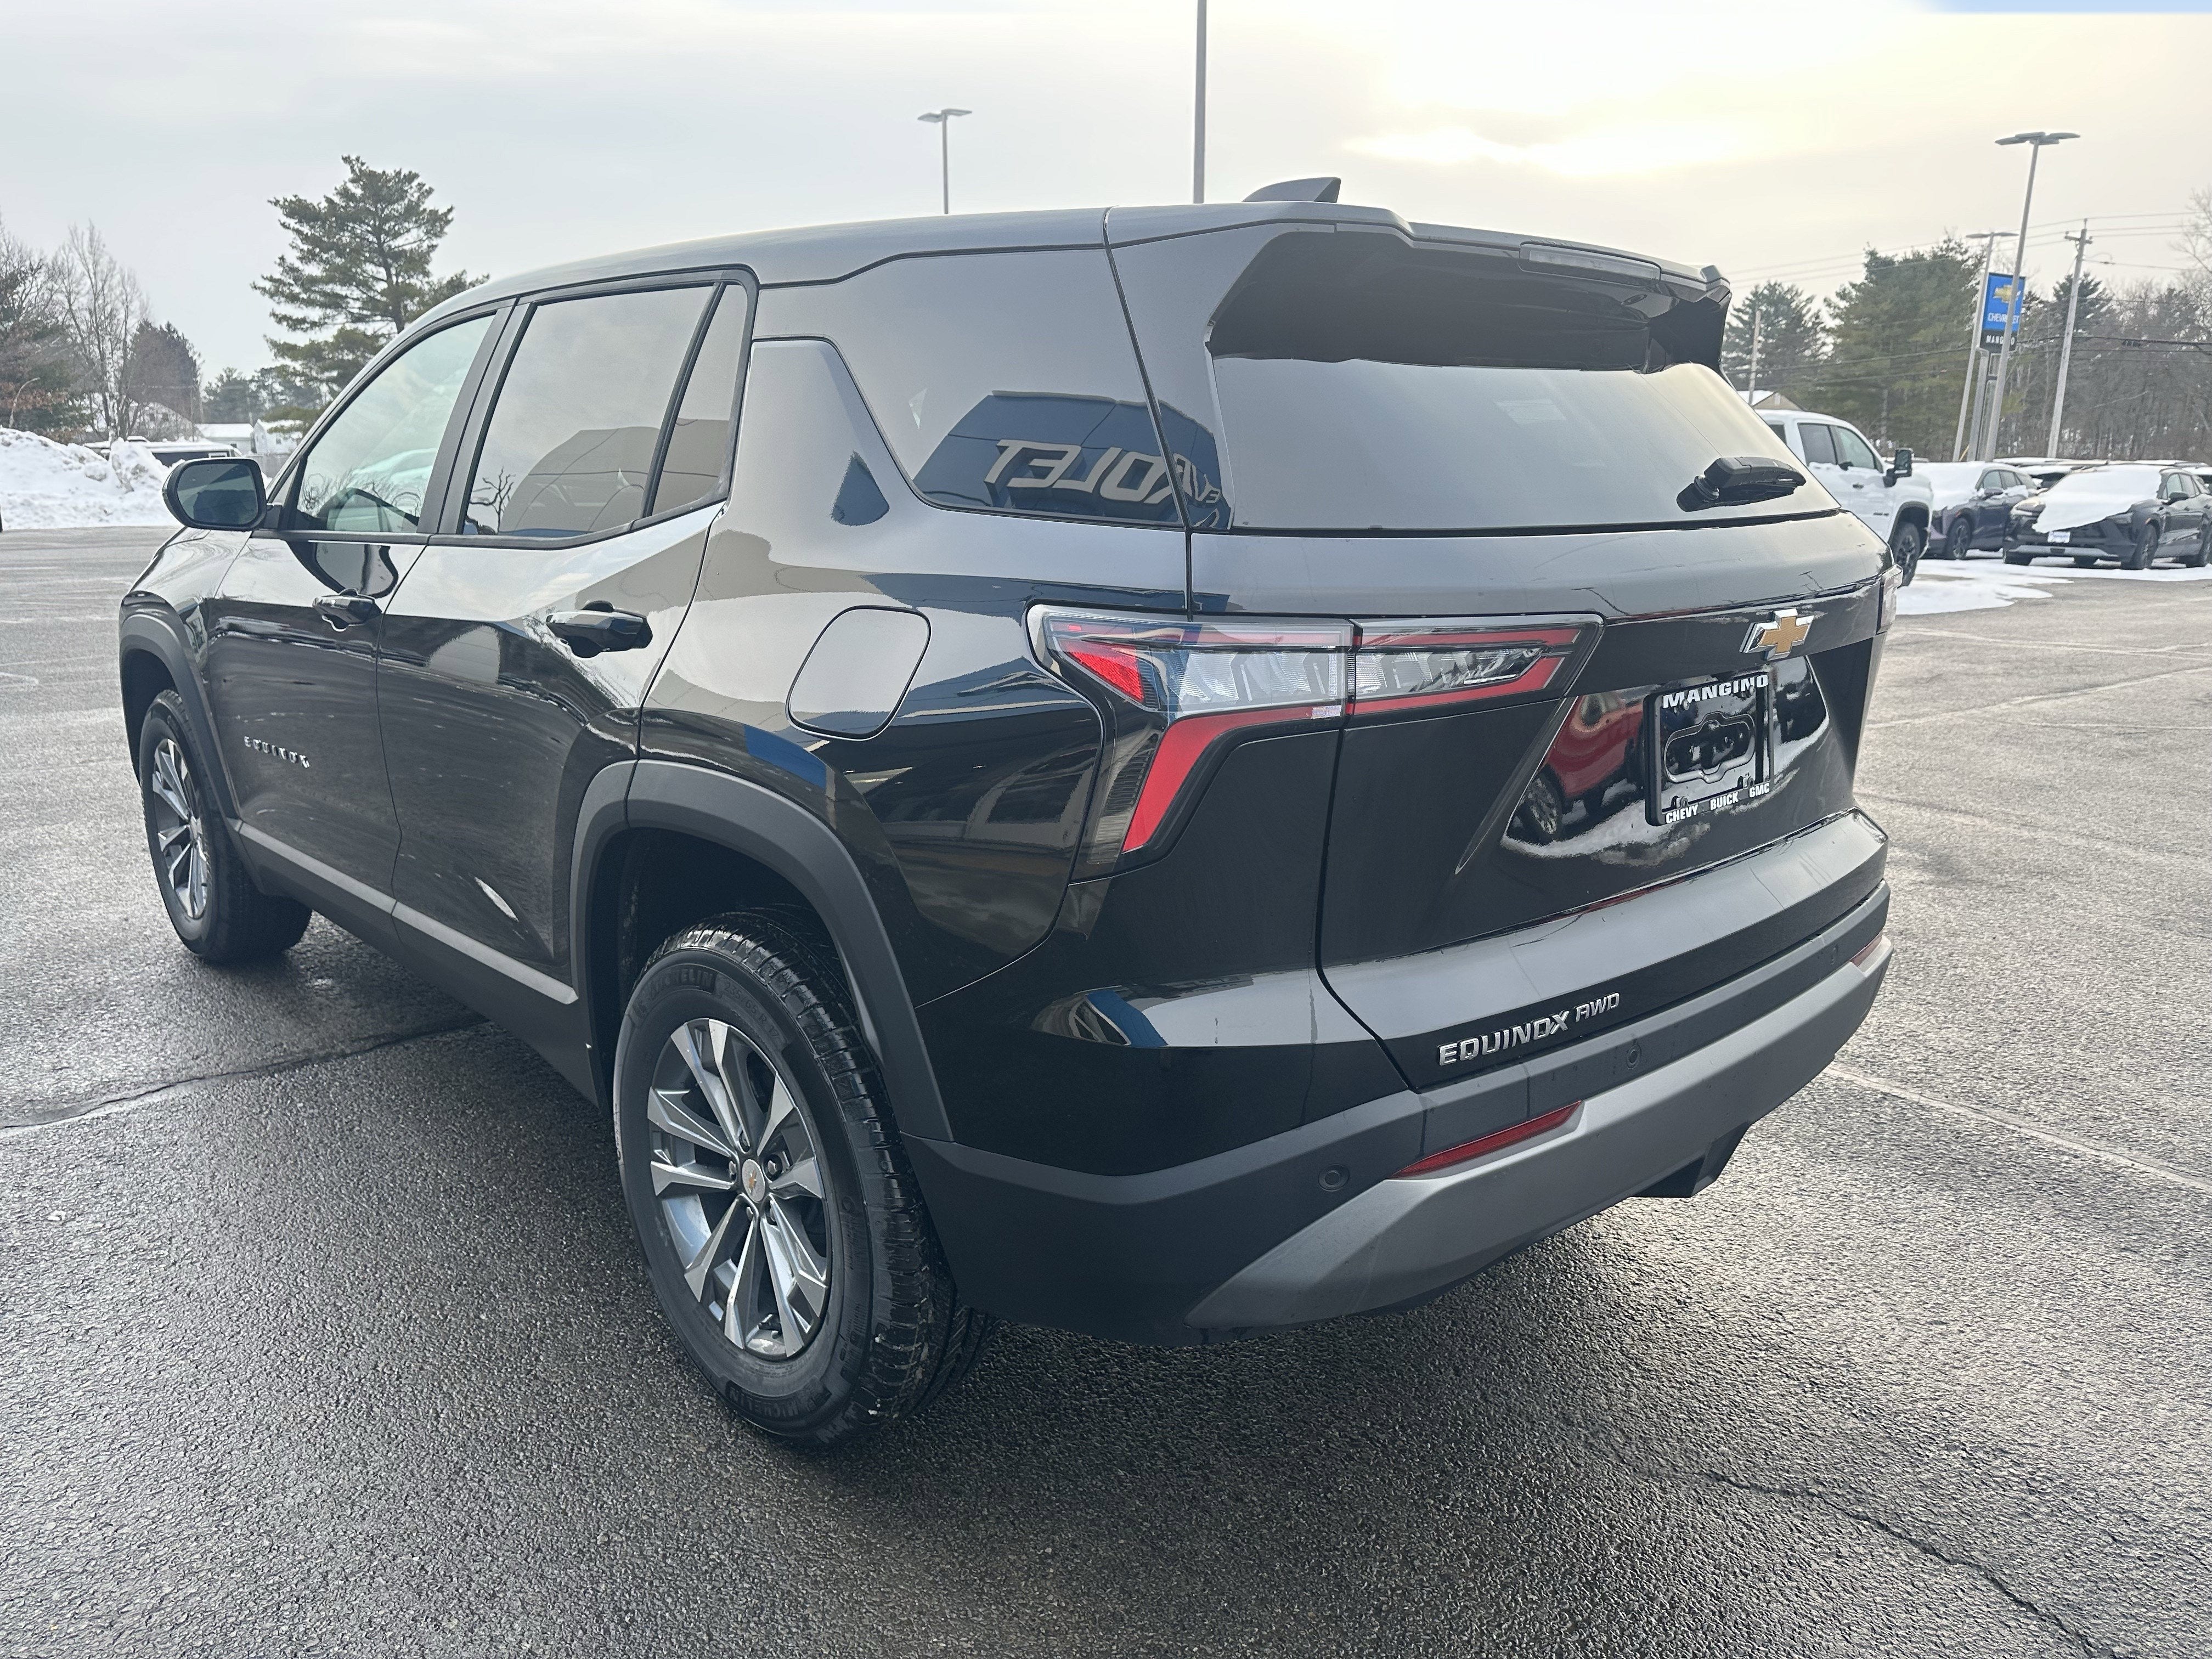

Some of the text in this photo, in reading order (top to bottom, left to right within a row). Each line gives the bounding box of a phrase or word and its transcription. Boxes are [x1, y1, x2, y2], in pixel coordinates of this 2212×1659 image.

[1988, 312, 2020, 324] CHEVRET
[1986, 335, 2015, 345] MANGO
[1662, 674, 1769, 709] MANGINO
[244, 736, 310, 768] EQUINOX
[1666, 782, 1770, 823] CHEVY BUICK GMC
[724, 982, 759, 1014] 235/65
[1437, 992, 1620, 1066] EQUINOX AWD
